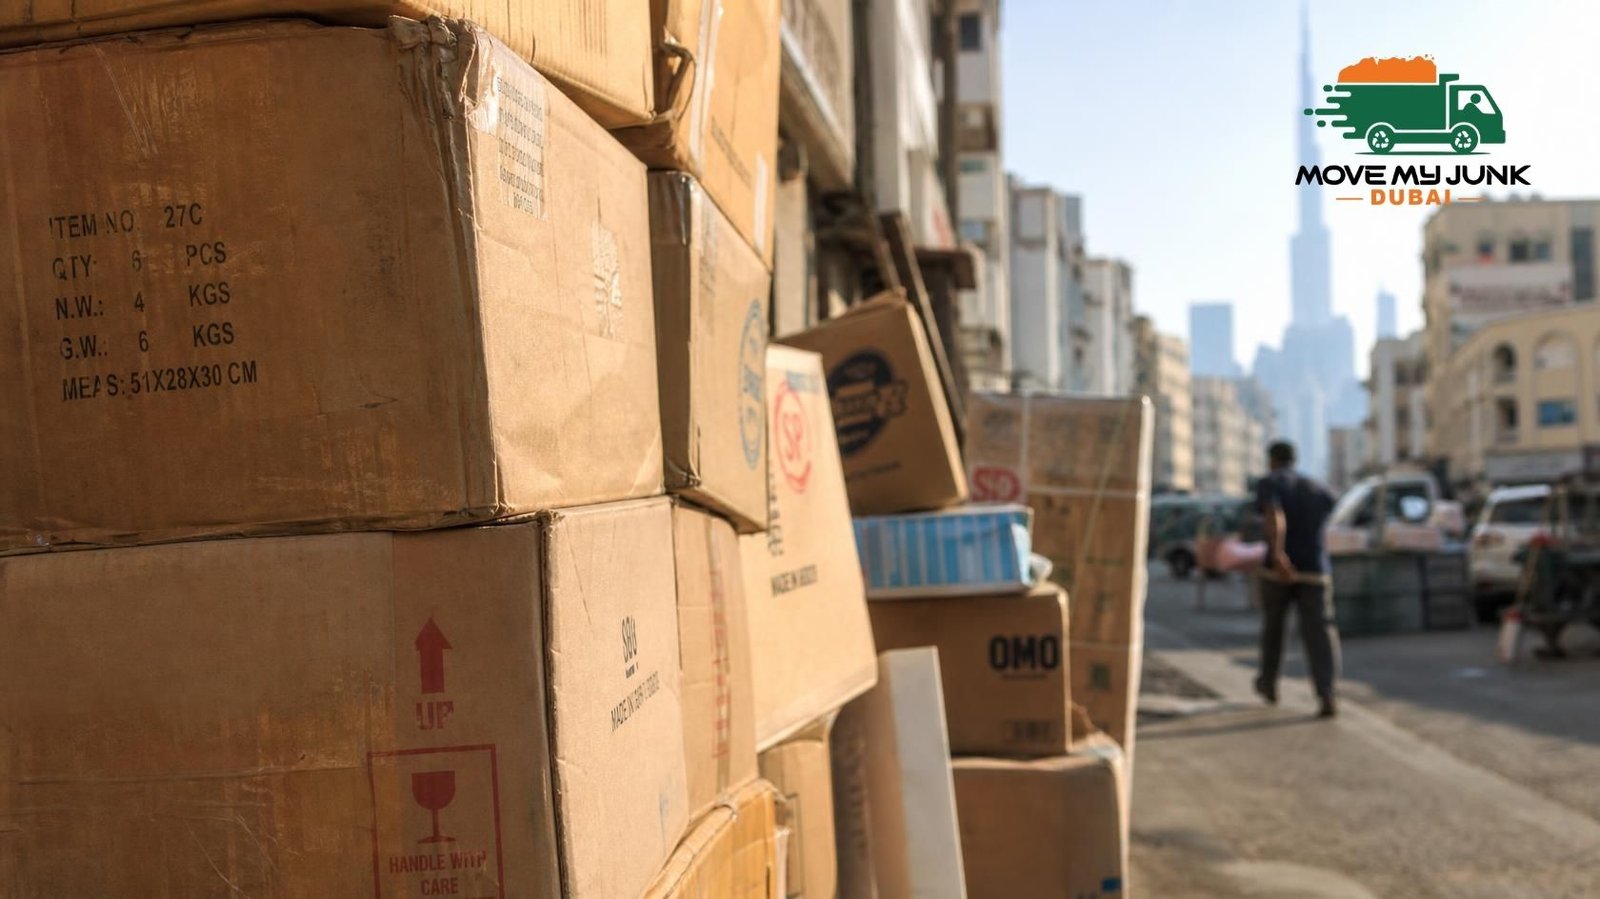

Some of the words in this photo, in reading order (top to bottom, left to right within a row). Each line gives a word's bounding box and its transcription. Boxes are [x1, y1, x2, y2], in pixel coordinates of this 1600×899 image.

[49, 213, 97, 240] ITEM
[164, 203, 203, 229] 27C
[131, 250, 142, 272] 6
[185, 241, 227, 267] PCS
[55, 295, 104, 321] N.W.:
[134, 291, 144, 313] 4
[188, 281, 231, 308] KGS
[138, 330, 149, 353] 6
[192, 322, 234, 348] KGS
[62, 373, 126, 402] MEAS:
[130, 364, 222, 395] 51X28X30
[227, 360, 257, 386] CM
[988, 633, 1060, 671] OMO
[415, 700, 454, 730] UP
[389, 854, 446, 873] HANDLE
[420, 877, 460, 896] CARE
